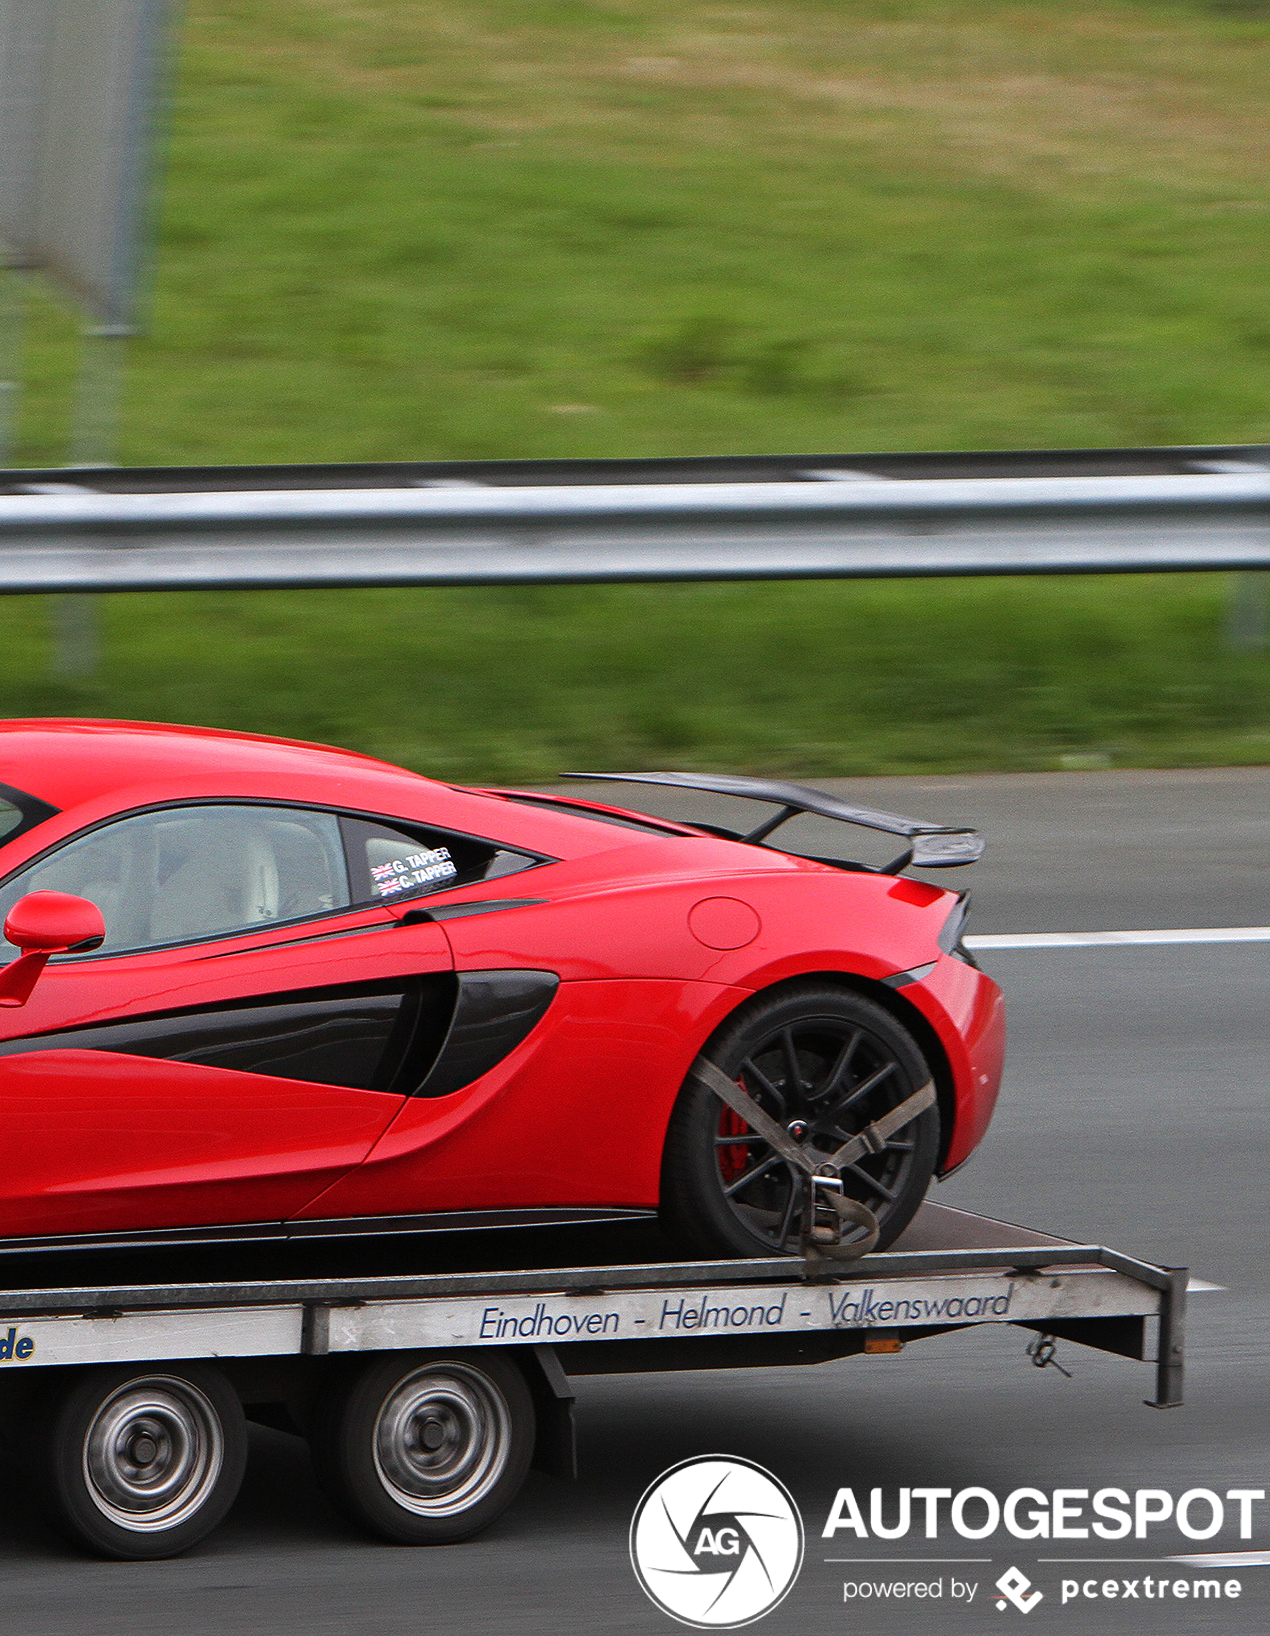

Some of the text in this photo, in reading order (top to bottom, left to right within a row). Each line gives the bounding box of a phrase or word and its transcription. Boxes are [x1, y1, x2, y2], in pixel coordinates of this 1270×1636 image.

[392, 847, 451, 873] G. TAPPER
[399, 861, 457, 889] C. TAPPER
[480, 1303, 619, 1339] Eindhoven
[659, 1294, 787, 1330] Helmond
[828, 1282, 1014, 1323] Valkenswaard
